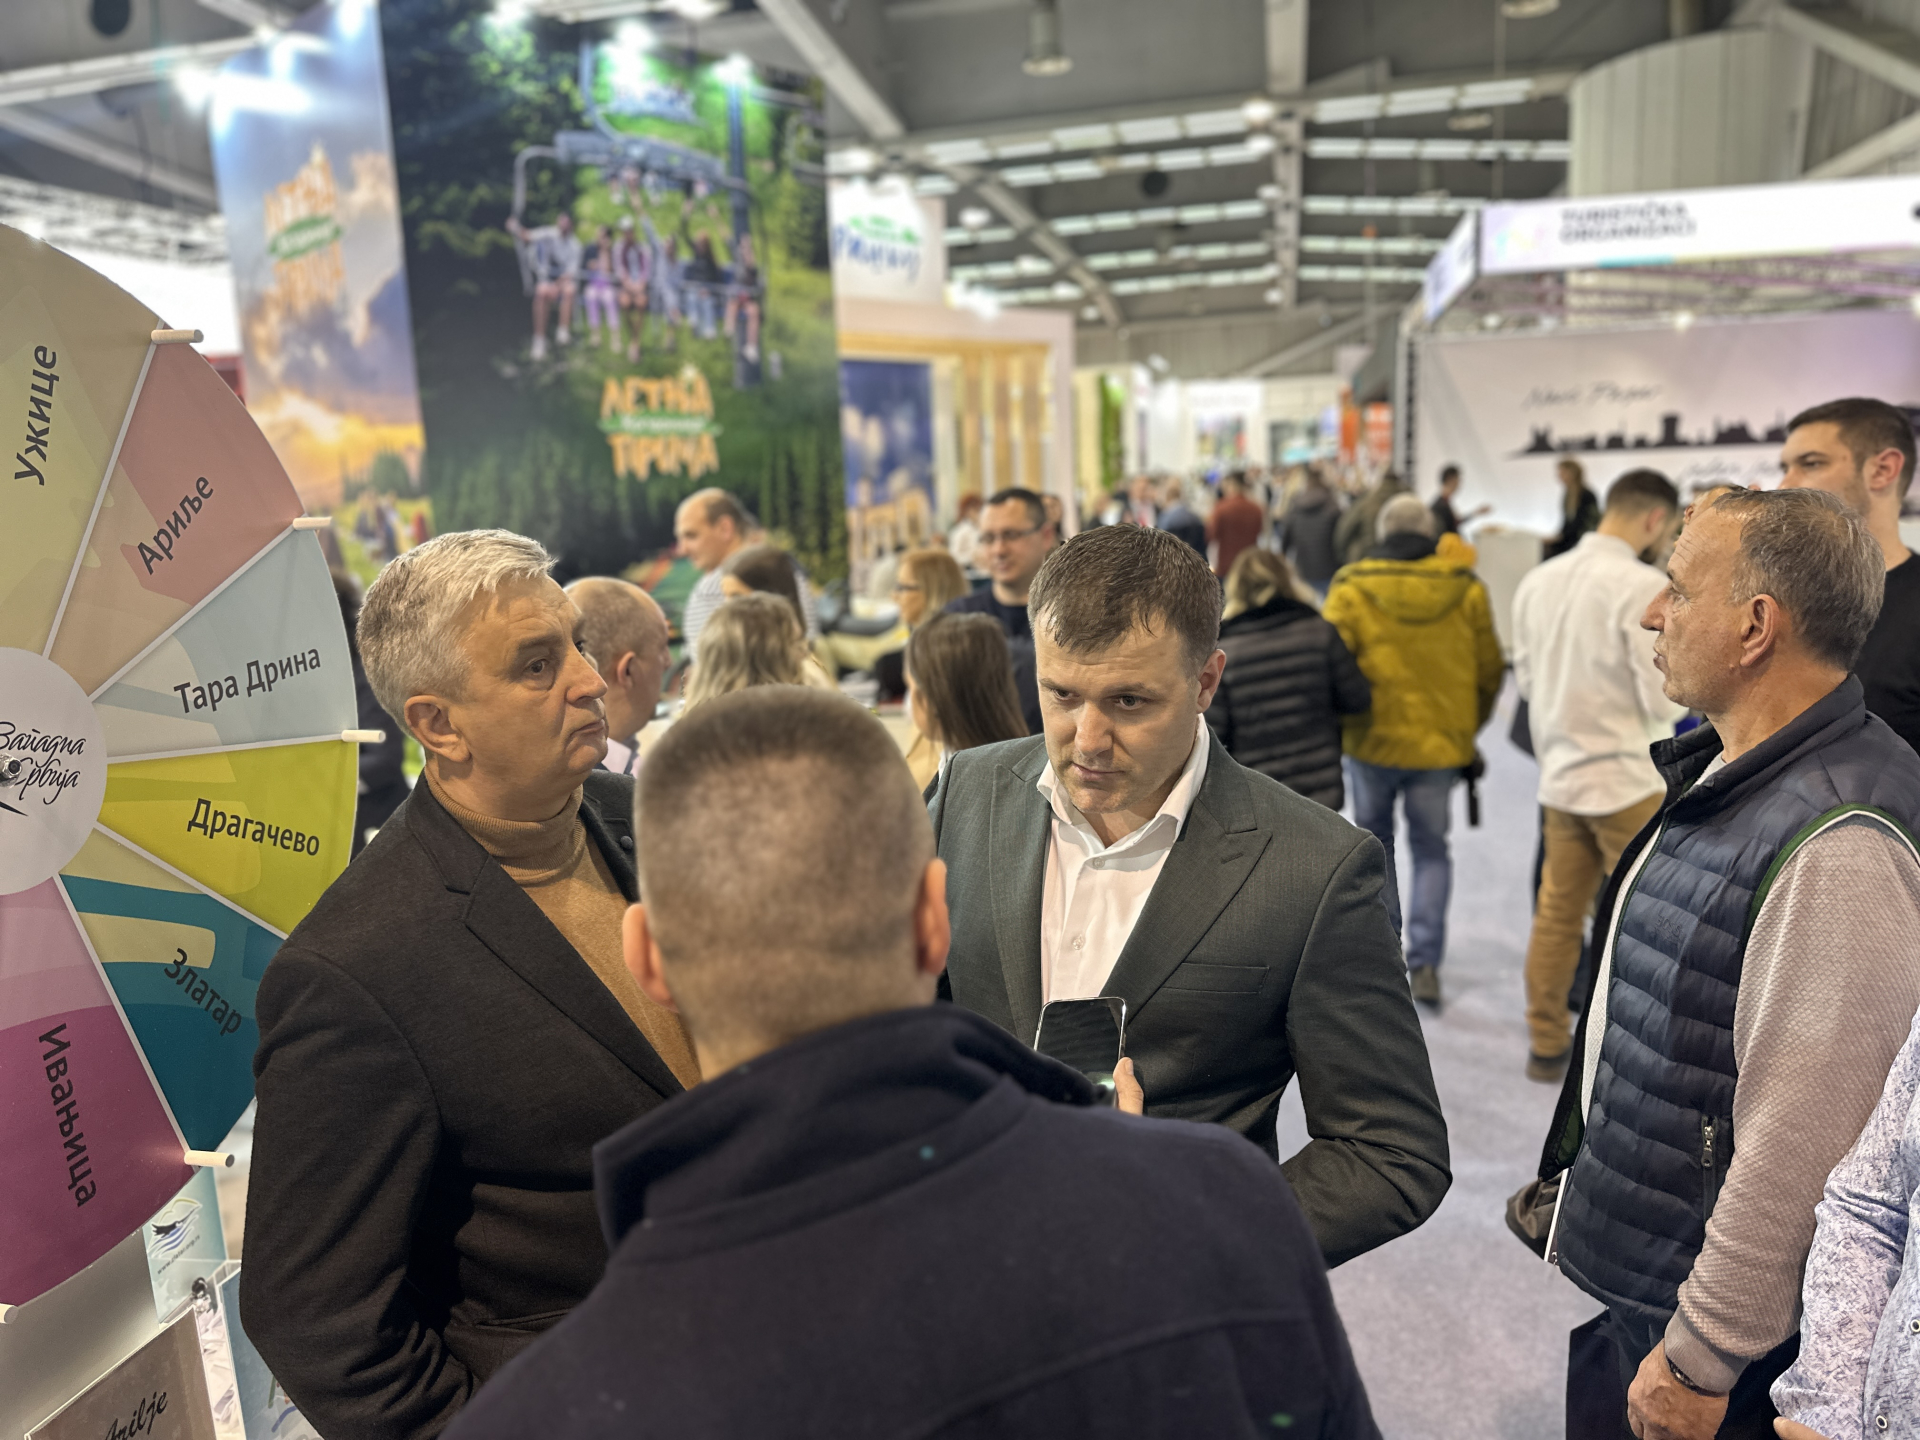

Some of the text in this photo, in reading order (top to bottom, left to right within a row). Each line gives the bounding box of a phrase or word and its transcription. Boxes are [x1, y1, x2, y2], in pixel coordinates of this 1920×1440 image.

[14, 344, 60, 486] Ужице
[136, 476, 215, 576] Ариље
[173, 648, 322, 714] Тара Дрина
[186, 797, 321, 857] Драгачево
[163, 948, 243, 1037] Златар
[38, 1022, 98, 1207] Ивањица
